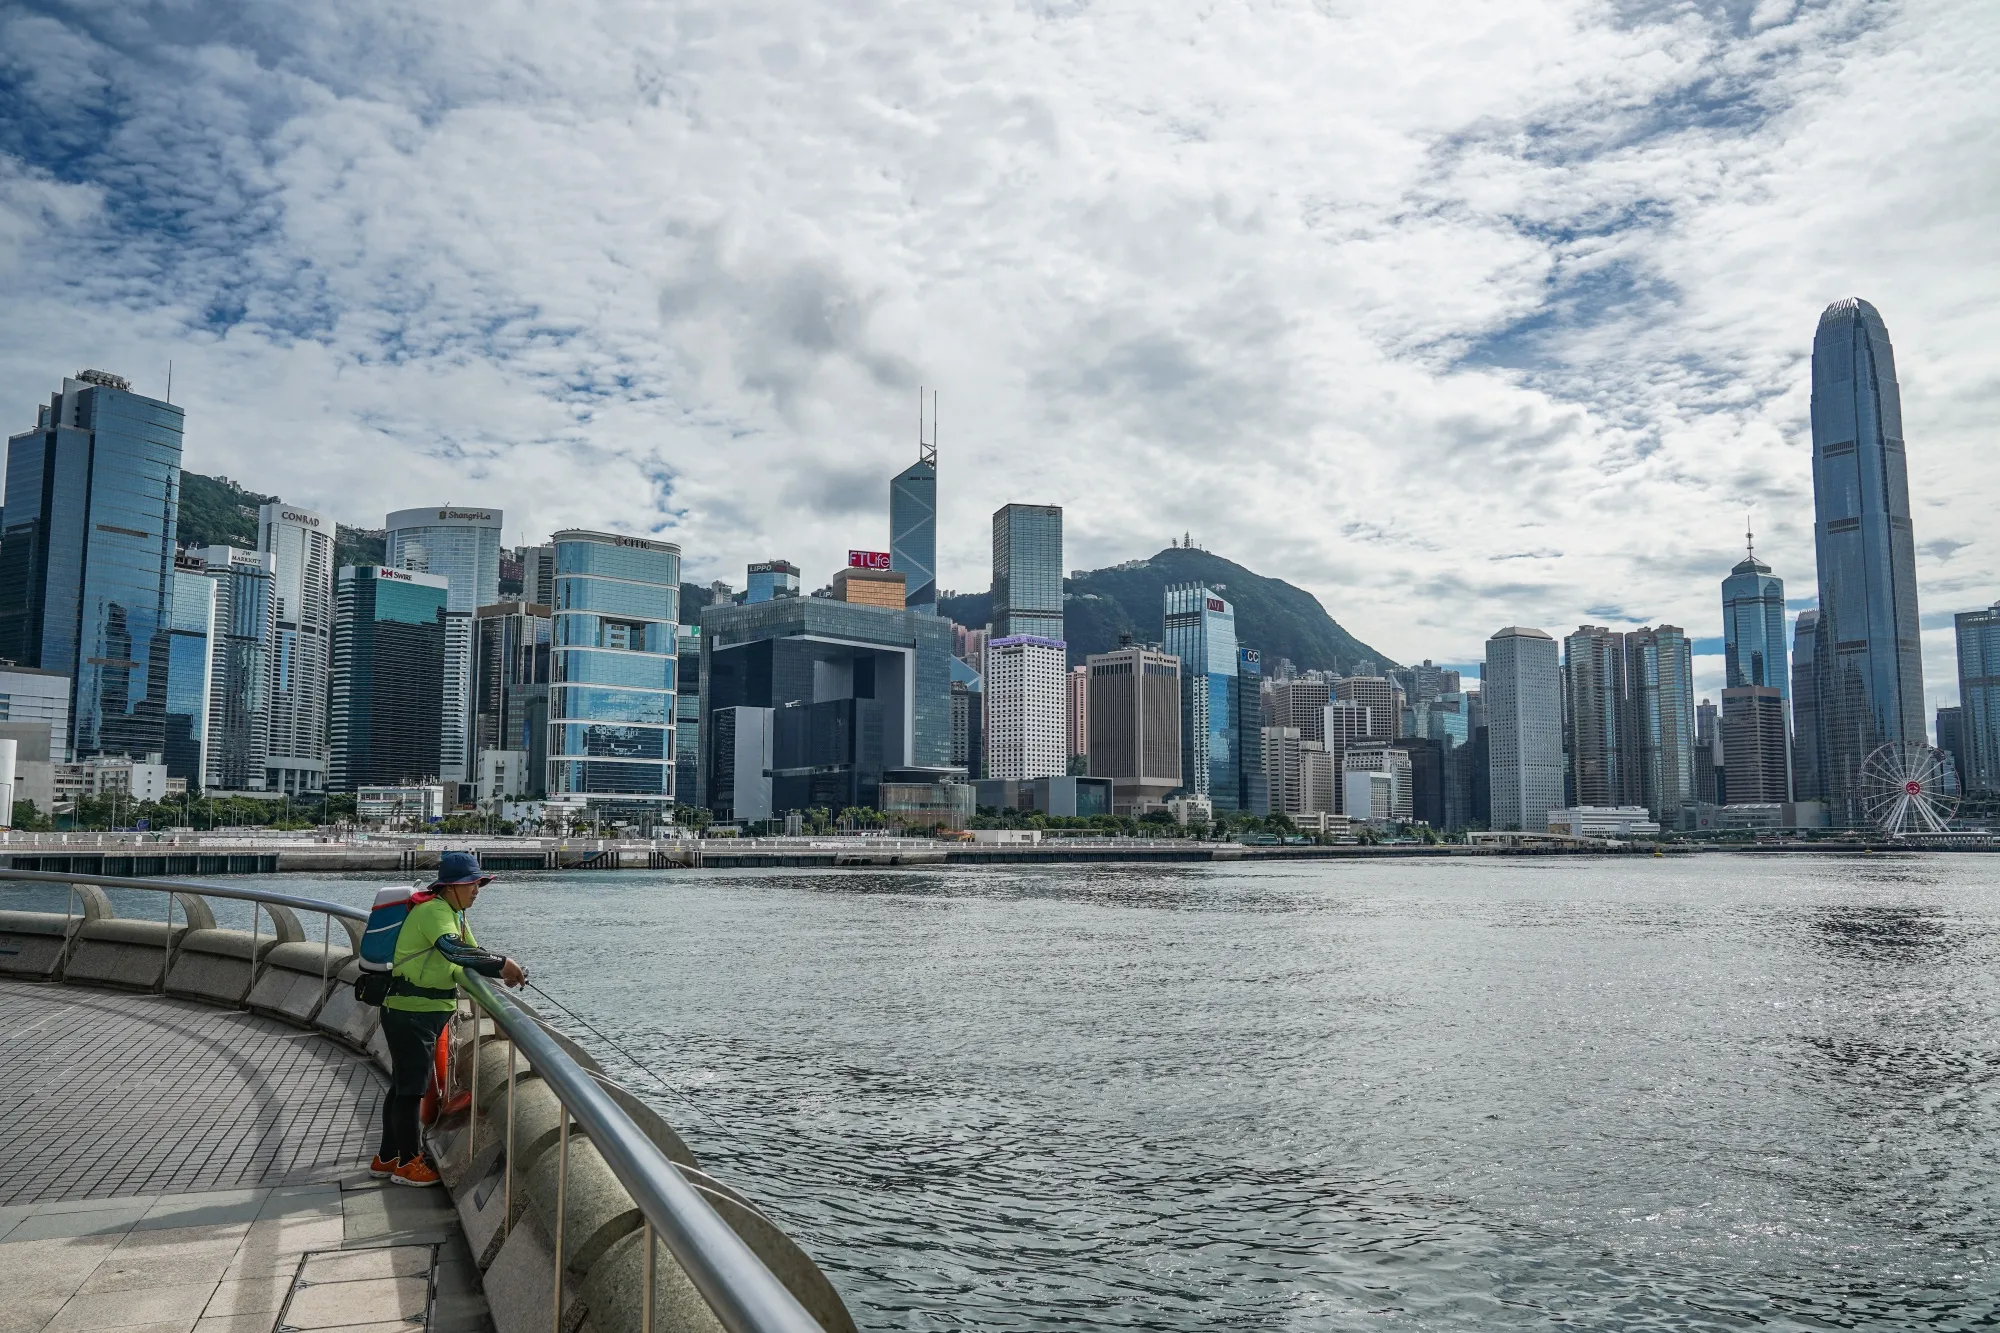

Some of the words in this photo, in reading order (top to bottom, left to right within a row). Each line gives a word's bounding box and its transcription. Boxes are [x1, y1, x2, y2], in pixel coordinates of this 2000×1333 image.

[281, 511, 320, 527] CONRAD
[448, 511, 491, 521] Shangri-La
[624, 538, 650, 549] CITIC
[849, 551, 890, 567] FTLife
[749, 564, 772, 572] LIPPO
